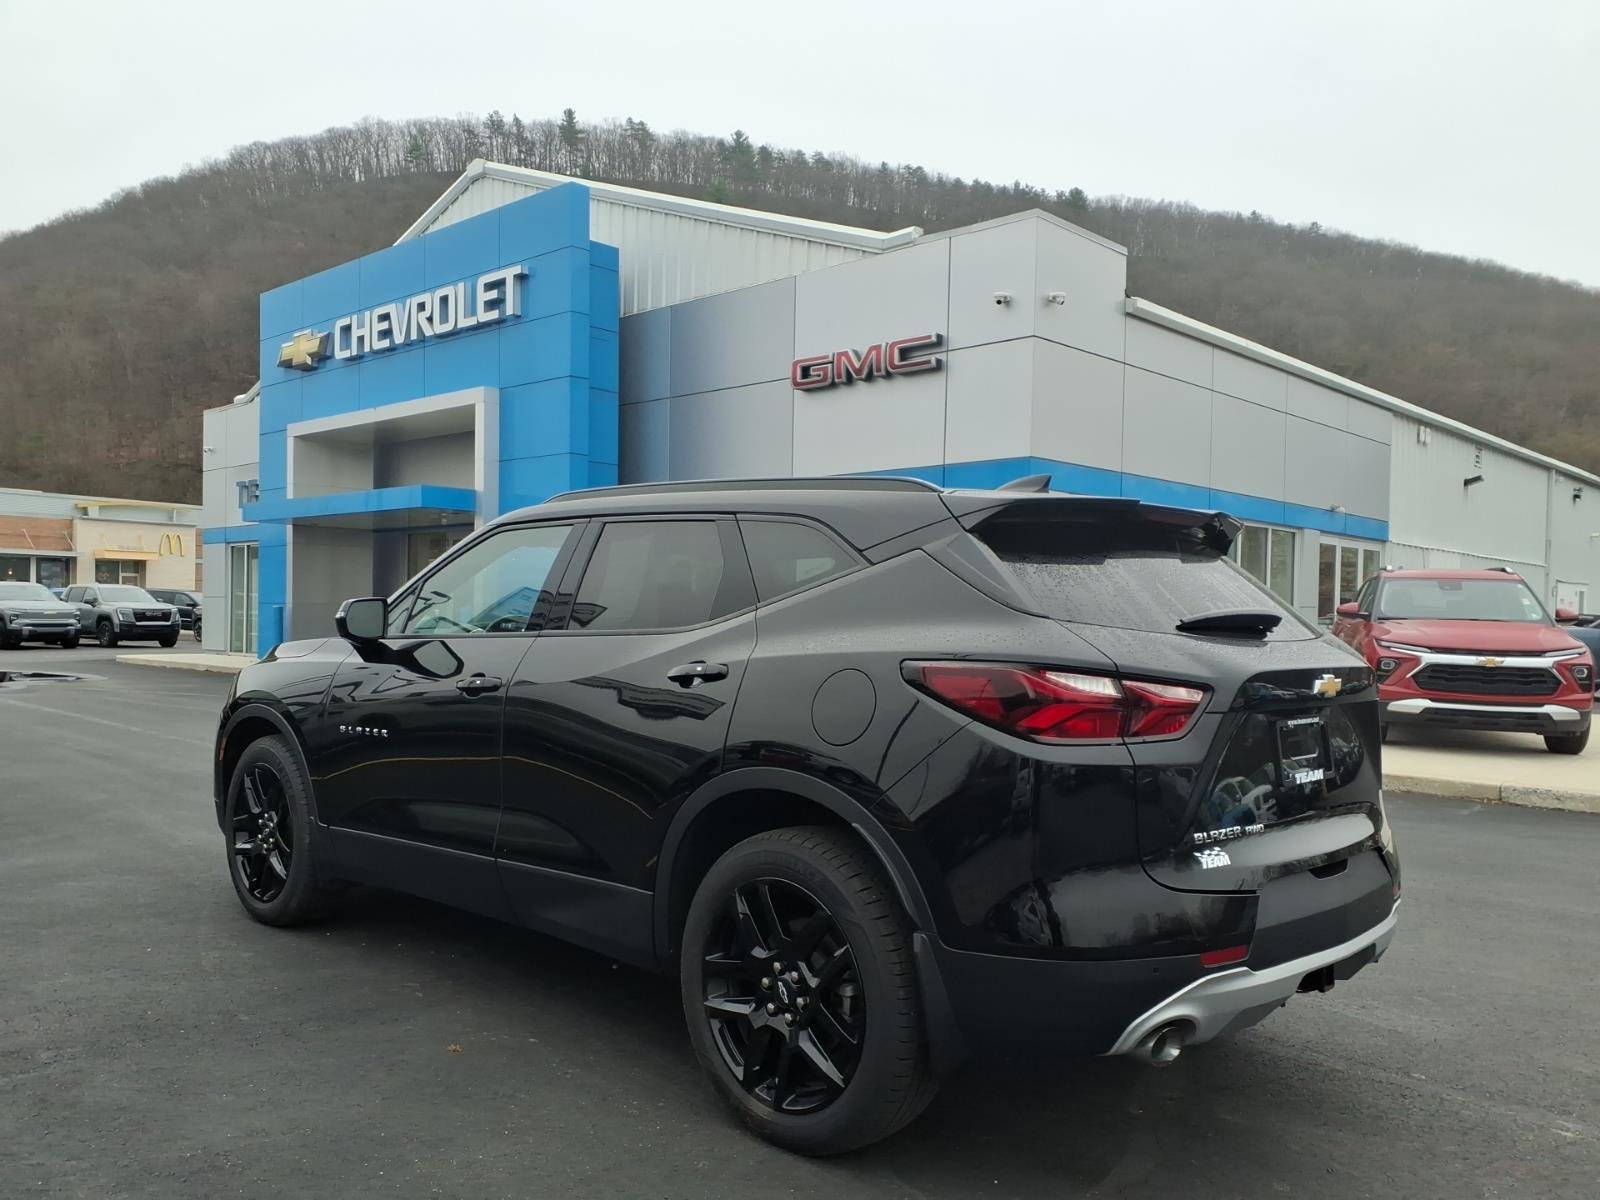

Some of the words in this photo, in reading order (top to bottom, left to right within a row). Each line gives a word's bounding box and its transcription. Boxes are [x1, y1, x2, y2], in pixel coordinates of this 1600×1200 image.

[335, 265, 525, 359] CHEVROLET
[791, 333, 942, 389] GMC
[339, 725, 388, 737] BLAZER
[1295, 769, 1323, 784] TEAM
[1194, 826, 1241, 844] BLAZER
[1198, 855, 1231, 869] TEAM
